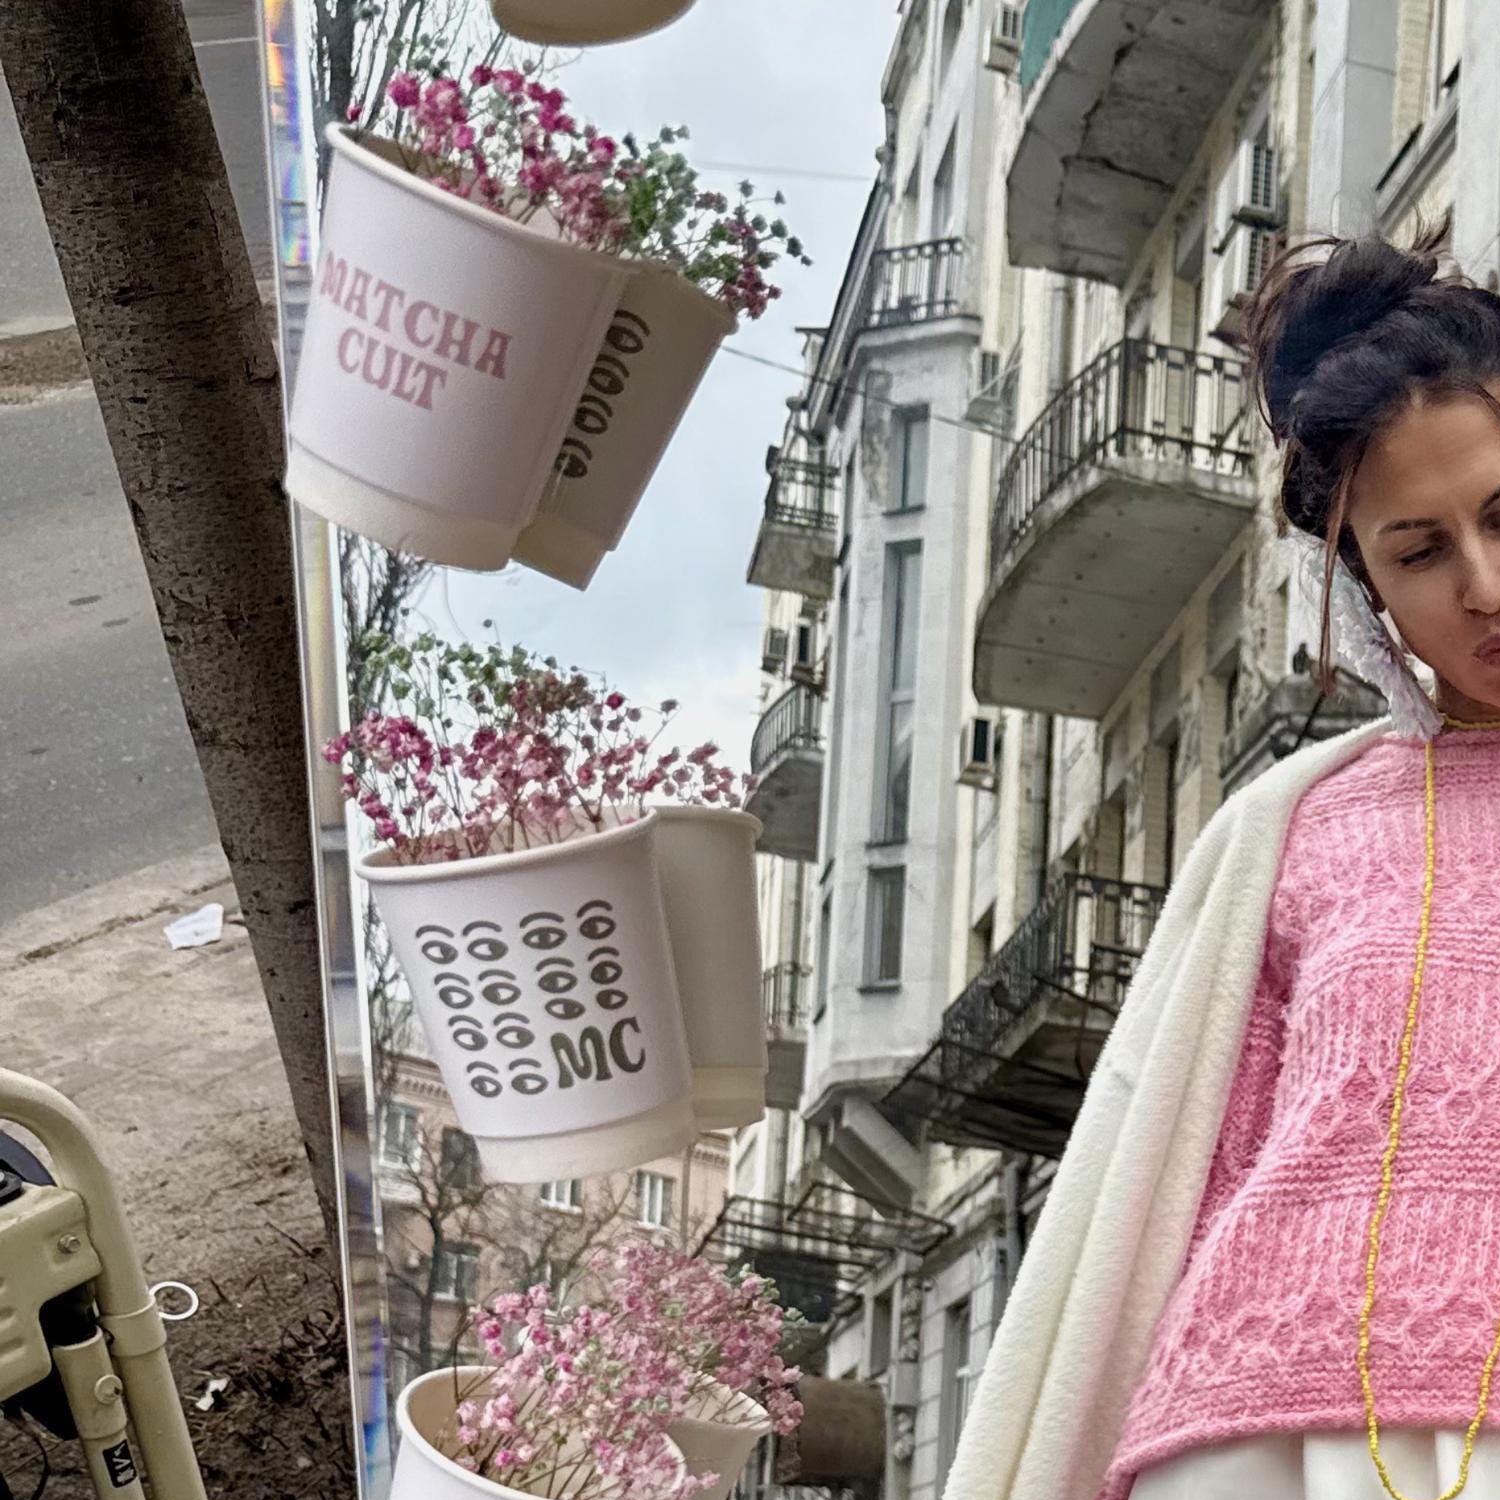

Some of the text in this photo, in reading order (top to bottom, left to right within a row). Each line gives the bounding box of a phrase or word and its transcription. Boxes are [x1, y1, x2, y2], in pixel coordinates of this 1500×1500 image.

[320, 251, 513, 381] MATCHA
[337, 327, 448, 411] CULT
[550, 1016, 646, 1089] MC
